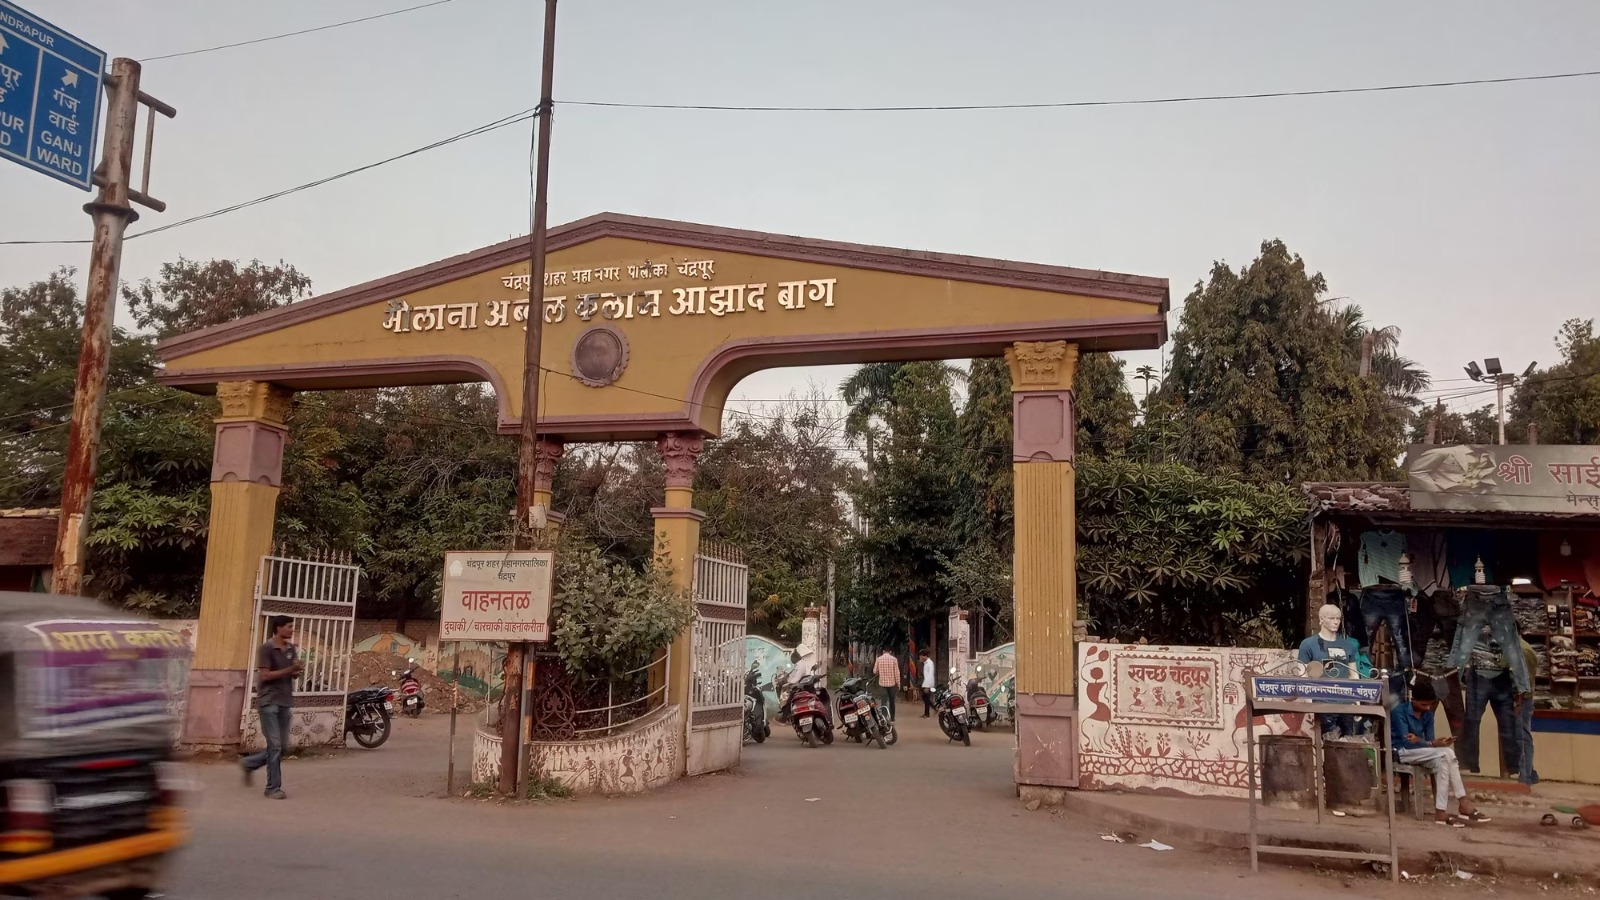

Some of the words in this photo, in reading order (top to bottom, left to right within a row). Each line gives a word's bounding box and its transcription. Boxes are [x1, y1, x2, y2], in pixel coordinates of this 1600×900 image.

[53, 87, 80, 113] गंज
[0, 111, 24, 133] UR
[48, 110, 79, 135] वार्ड
[41, 130, 82, 158] GANJ
[37, 146, 83, 176] WARD
[676, 257, 715, 280] चंद्रपूर
[668, 282, 768, 316] आझाद
[777, 278, 838, 310] बाग
[1497, 455, 1532, 484] श्री
[466, 558, 485, 570] चंद्रपूर
[486, 560, 500, 569] शहर
[461, 590, 532, 612] वाहनतळ
[444, 618, 466, 635] दुचाकी
[474, 618, 503, 632] चारचाकी
[1128, 664, 1168, 683] स्वच्छ
[1280, 683, 1297, 695] शहर
